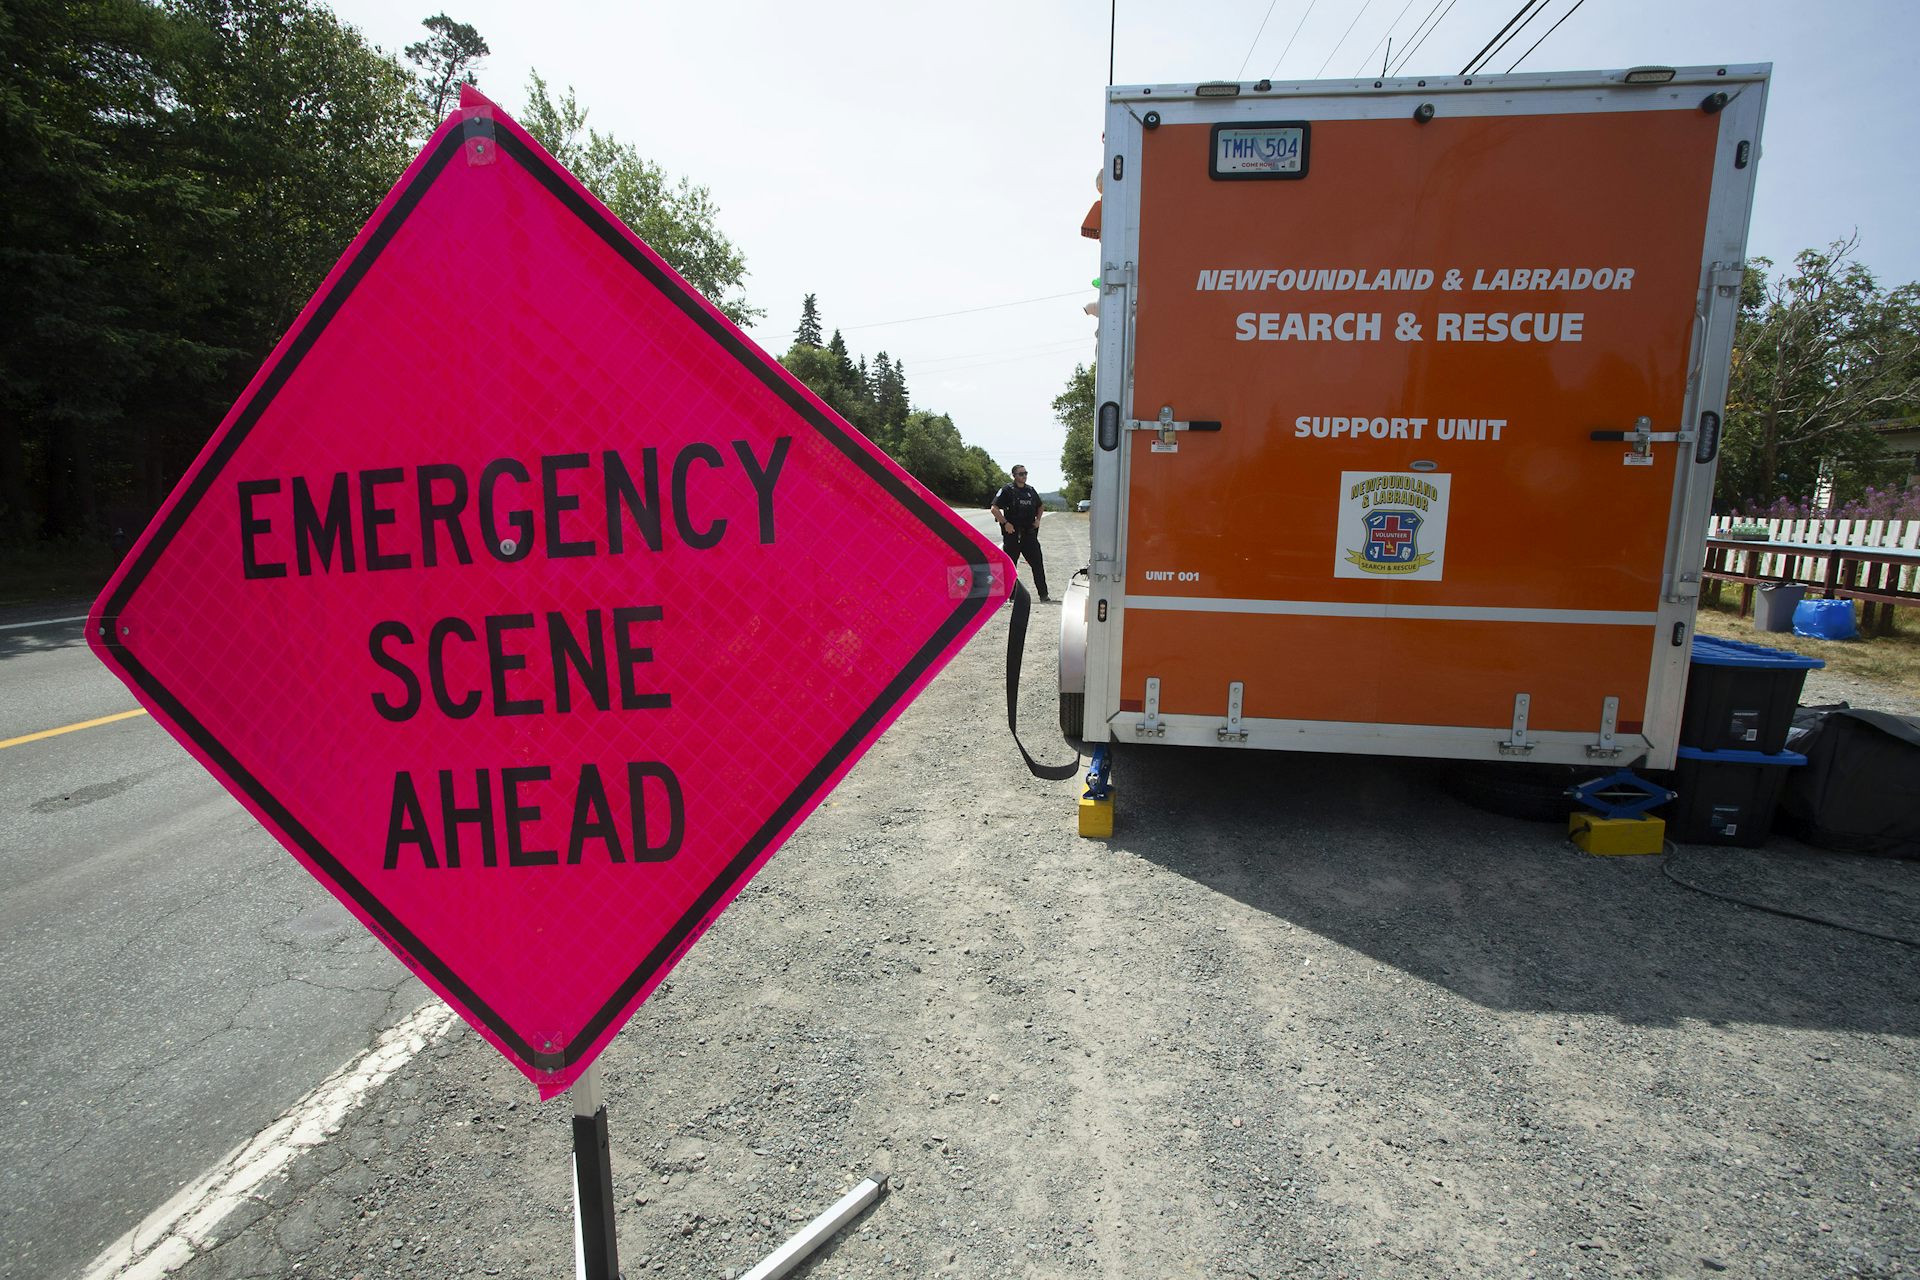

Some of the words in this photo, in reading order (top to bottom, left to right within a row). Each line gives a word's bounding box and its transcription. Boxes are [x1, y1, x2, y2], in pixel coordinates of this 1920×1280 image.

[1222, 138, 1253, 158] TMH
[1265, 137, 1298, 158] 504
[1196, 269, 1434, 291] NEWFOUNDLAND
[1442, 269, 1464, 291] &
[1472, 268, 1635, 290] LABRADOR
[1235, 312, 1382, 341] SEARCH
[1395, 312, 1424, 342] &
[1436, 312, 1584, 342] RESCUE
[1295, 416, 1428, 440] SUPPORT
[1437, 418, 1507, 441] UNIT
[1350, 475, 1438, 502] NEWFOUNDLAND
[1361, 495, 1370, 509] &
[1373, 490, 1429, 512] LABRADOR
[237, 436, 793, 579] EMERGENCY
[1145, 571, 1175, 581] UNIT
[1178, 572, 1200, 581] 001
[1361, 562, 1386, 571] SEARCH
[368, 605, 672, 723] SCENE
[382, 760, 686, 870] AHEAD
